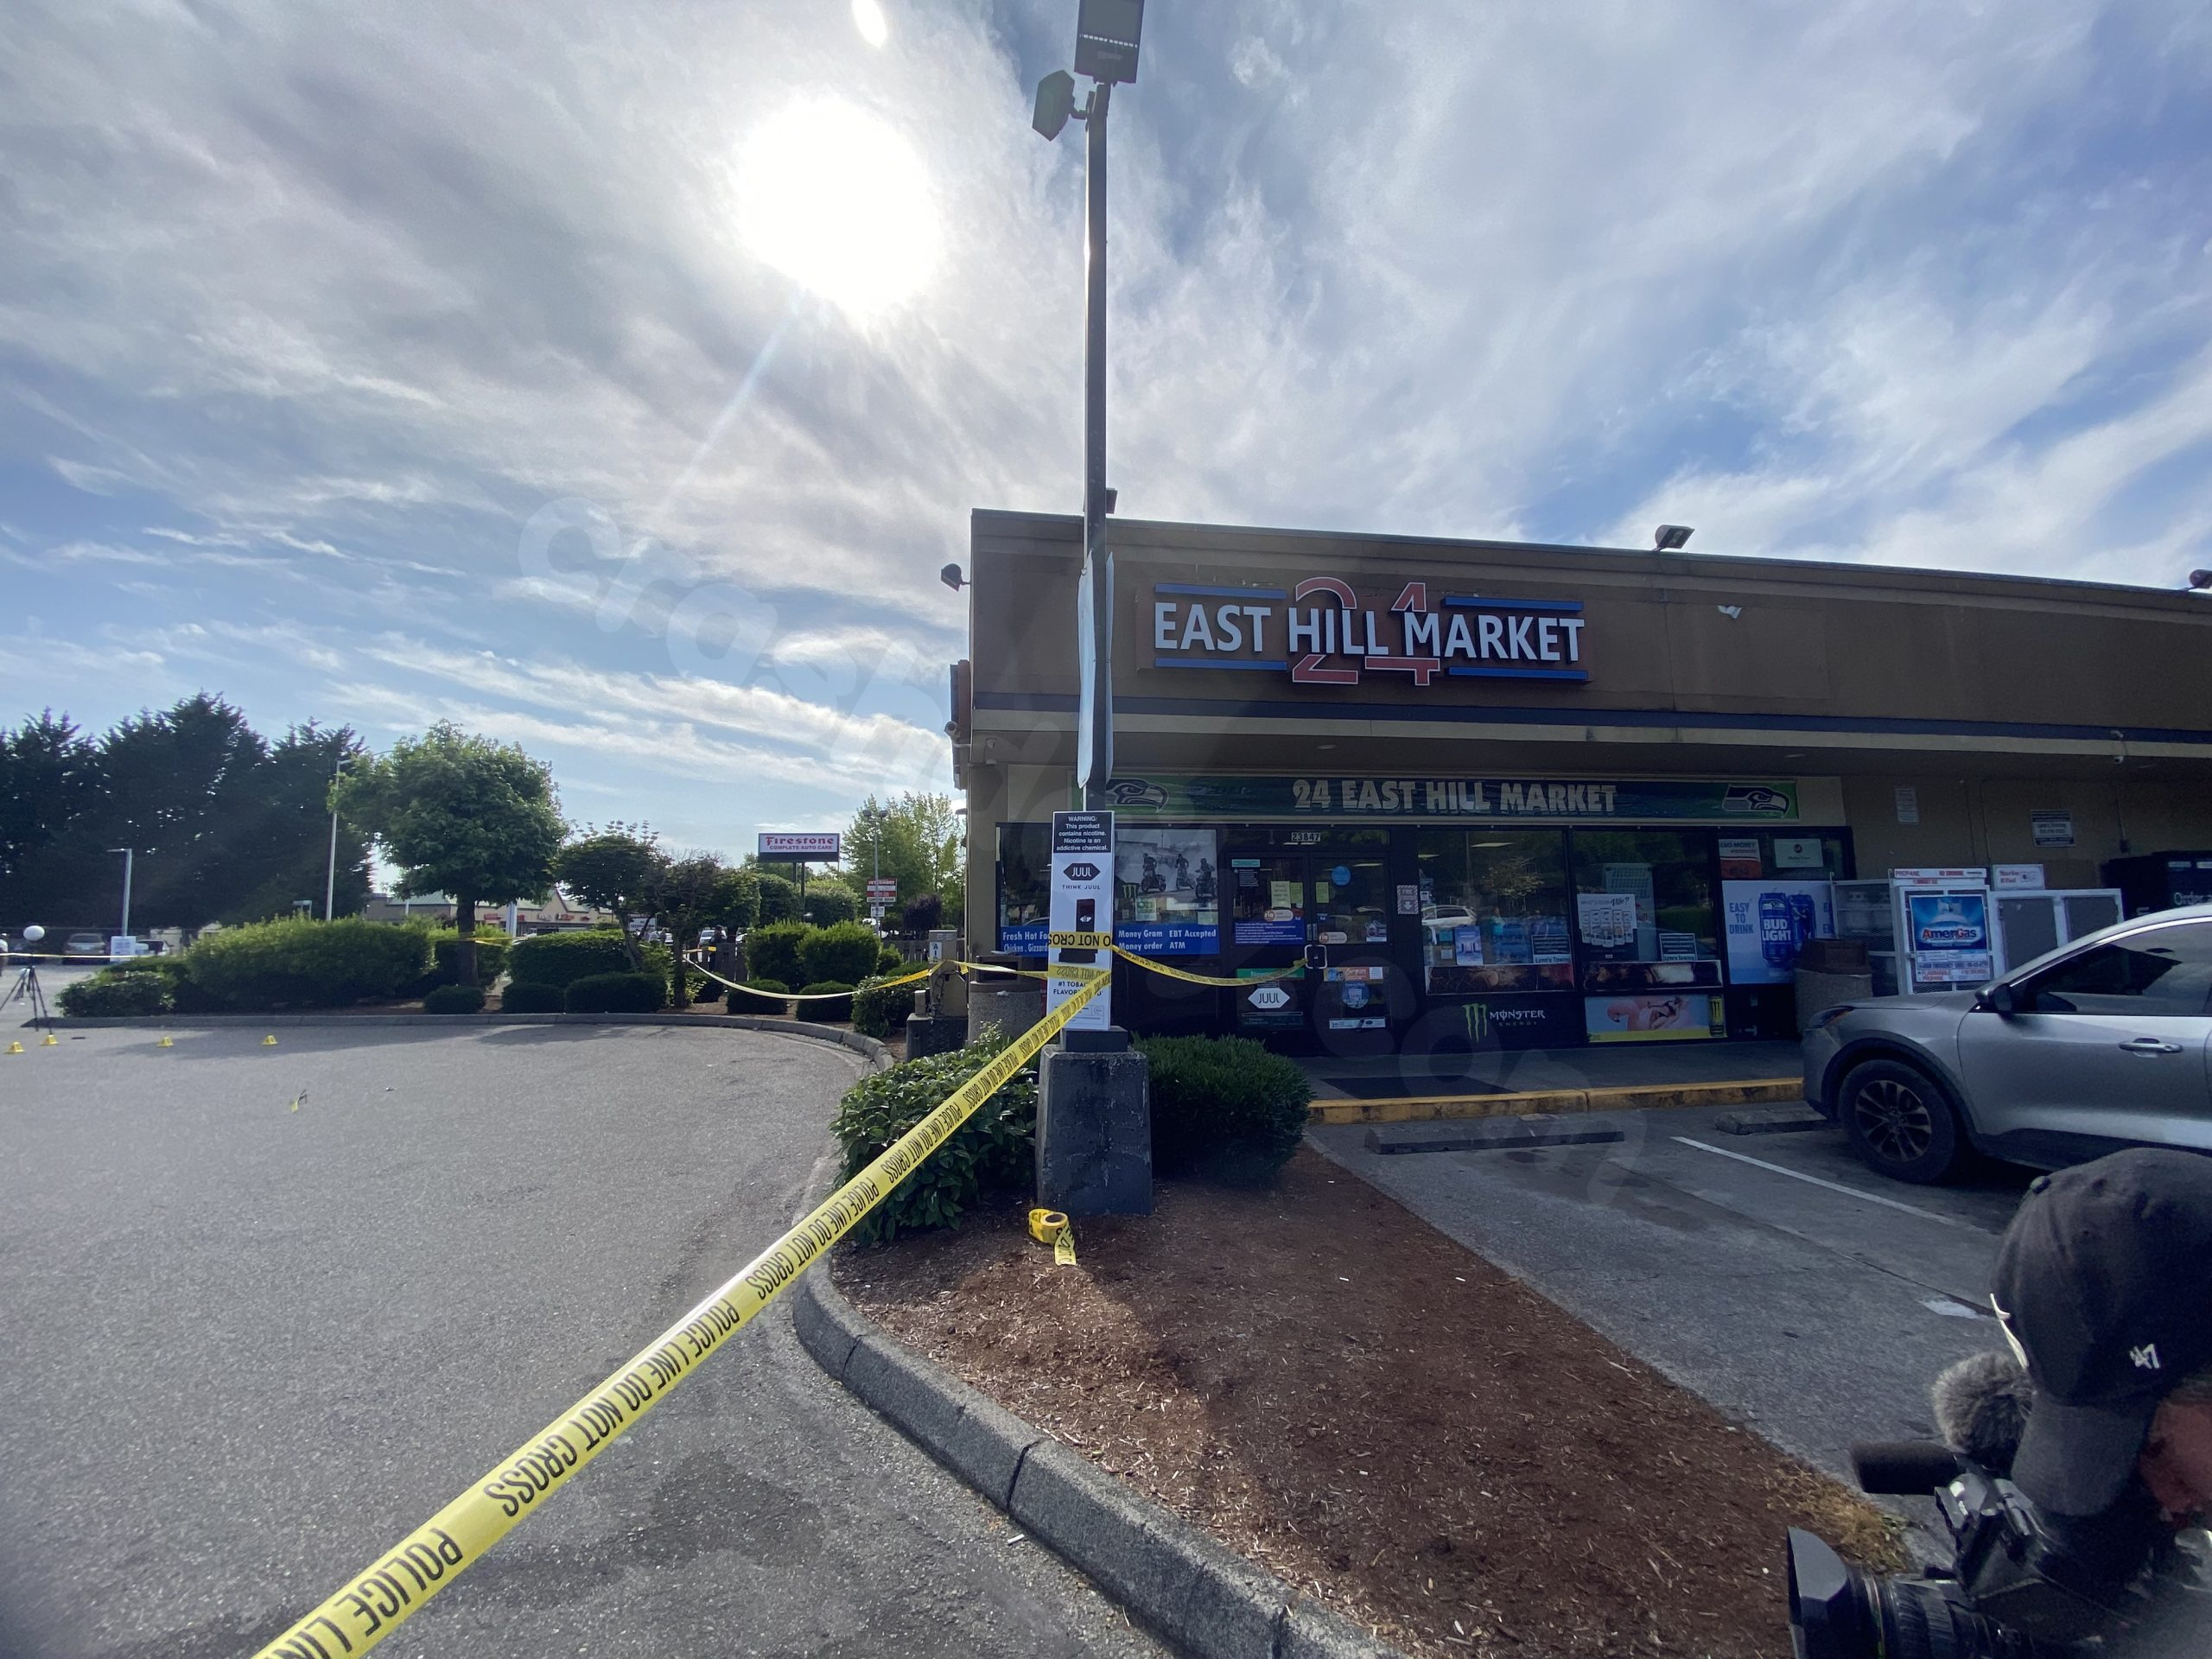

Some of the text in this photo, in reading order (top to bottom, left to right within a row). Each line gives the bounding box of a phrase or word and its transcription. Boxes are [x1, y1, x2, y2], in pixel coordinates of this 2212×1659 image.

[1154, 601, 1585, 662] EAST HILL MARKET
[1293, 576, 1440, 685] 24
[1293, 779, 1618, 814] 24 EAST HILL MARKET
[765, 836, 834, 846] Firestone
[1291, 832, 1320, 842] 23847
[1071, 867, 1091, 877] JUUL
[1729, 902, 1750, 912] EASY
[1735, 913, 1745, 923] TO
[1729, 924, 1753, 934] DRINK
[1764, 918, 1788, 930] BUD
[1002, 931, 1022, 940] Fresh
[1025, 931, 1038, 940] Hot
[1118, 929, 1163, 938] Money Gram
[1169, 929, 1217, 938] EBT Accepted
[1763, 930, 1791, 941] LIGHT
[1077, 934, 1100, 946] NOT
[1004, 944, 1023, 953] Chicken
[1118, 942, 1163, 952] Money order
[1169, 941, 1185, 950] ATM
[1258, 992, 1280, 1004] JUUL
[1490, 1009, 1546, 1020] MONSTER
[880, 1102, 963, 1183] POLICE LINE DO NOT CROSS
[745, 1177, 880, 1300] POLICE LINE DO NOT CROSS
[483, 1298, 741, 1517] POLICE LINE DO NOT CROSS
[333, 1527, 464, 1637] POLICE
